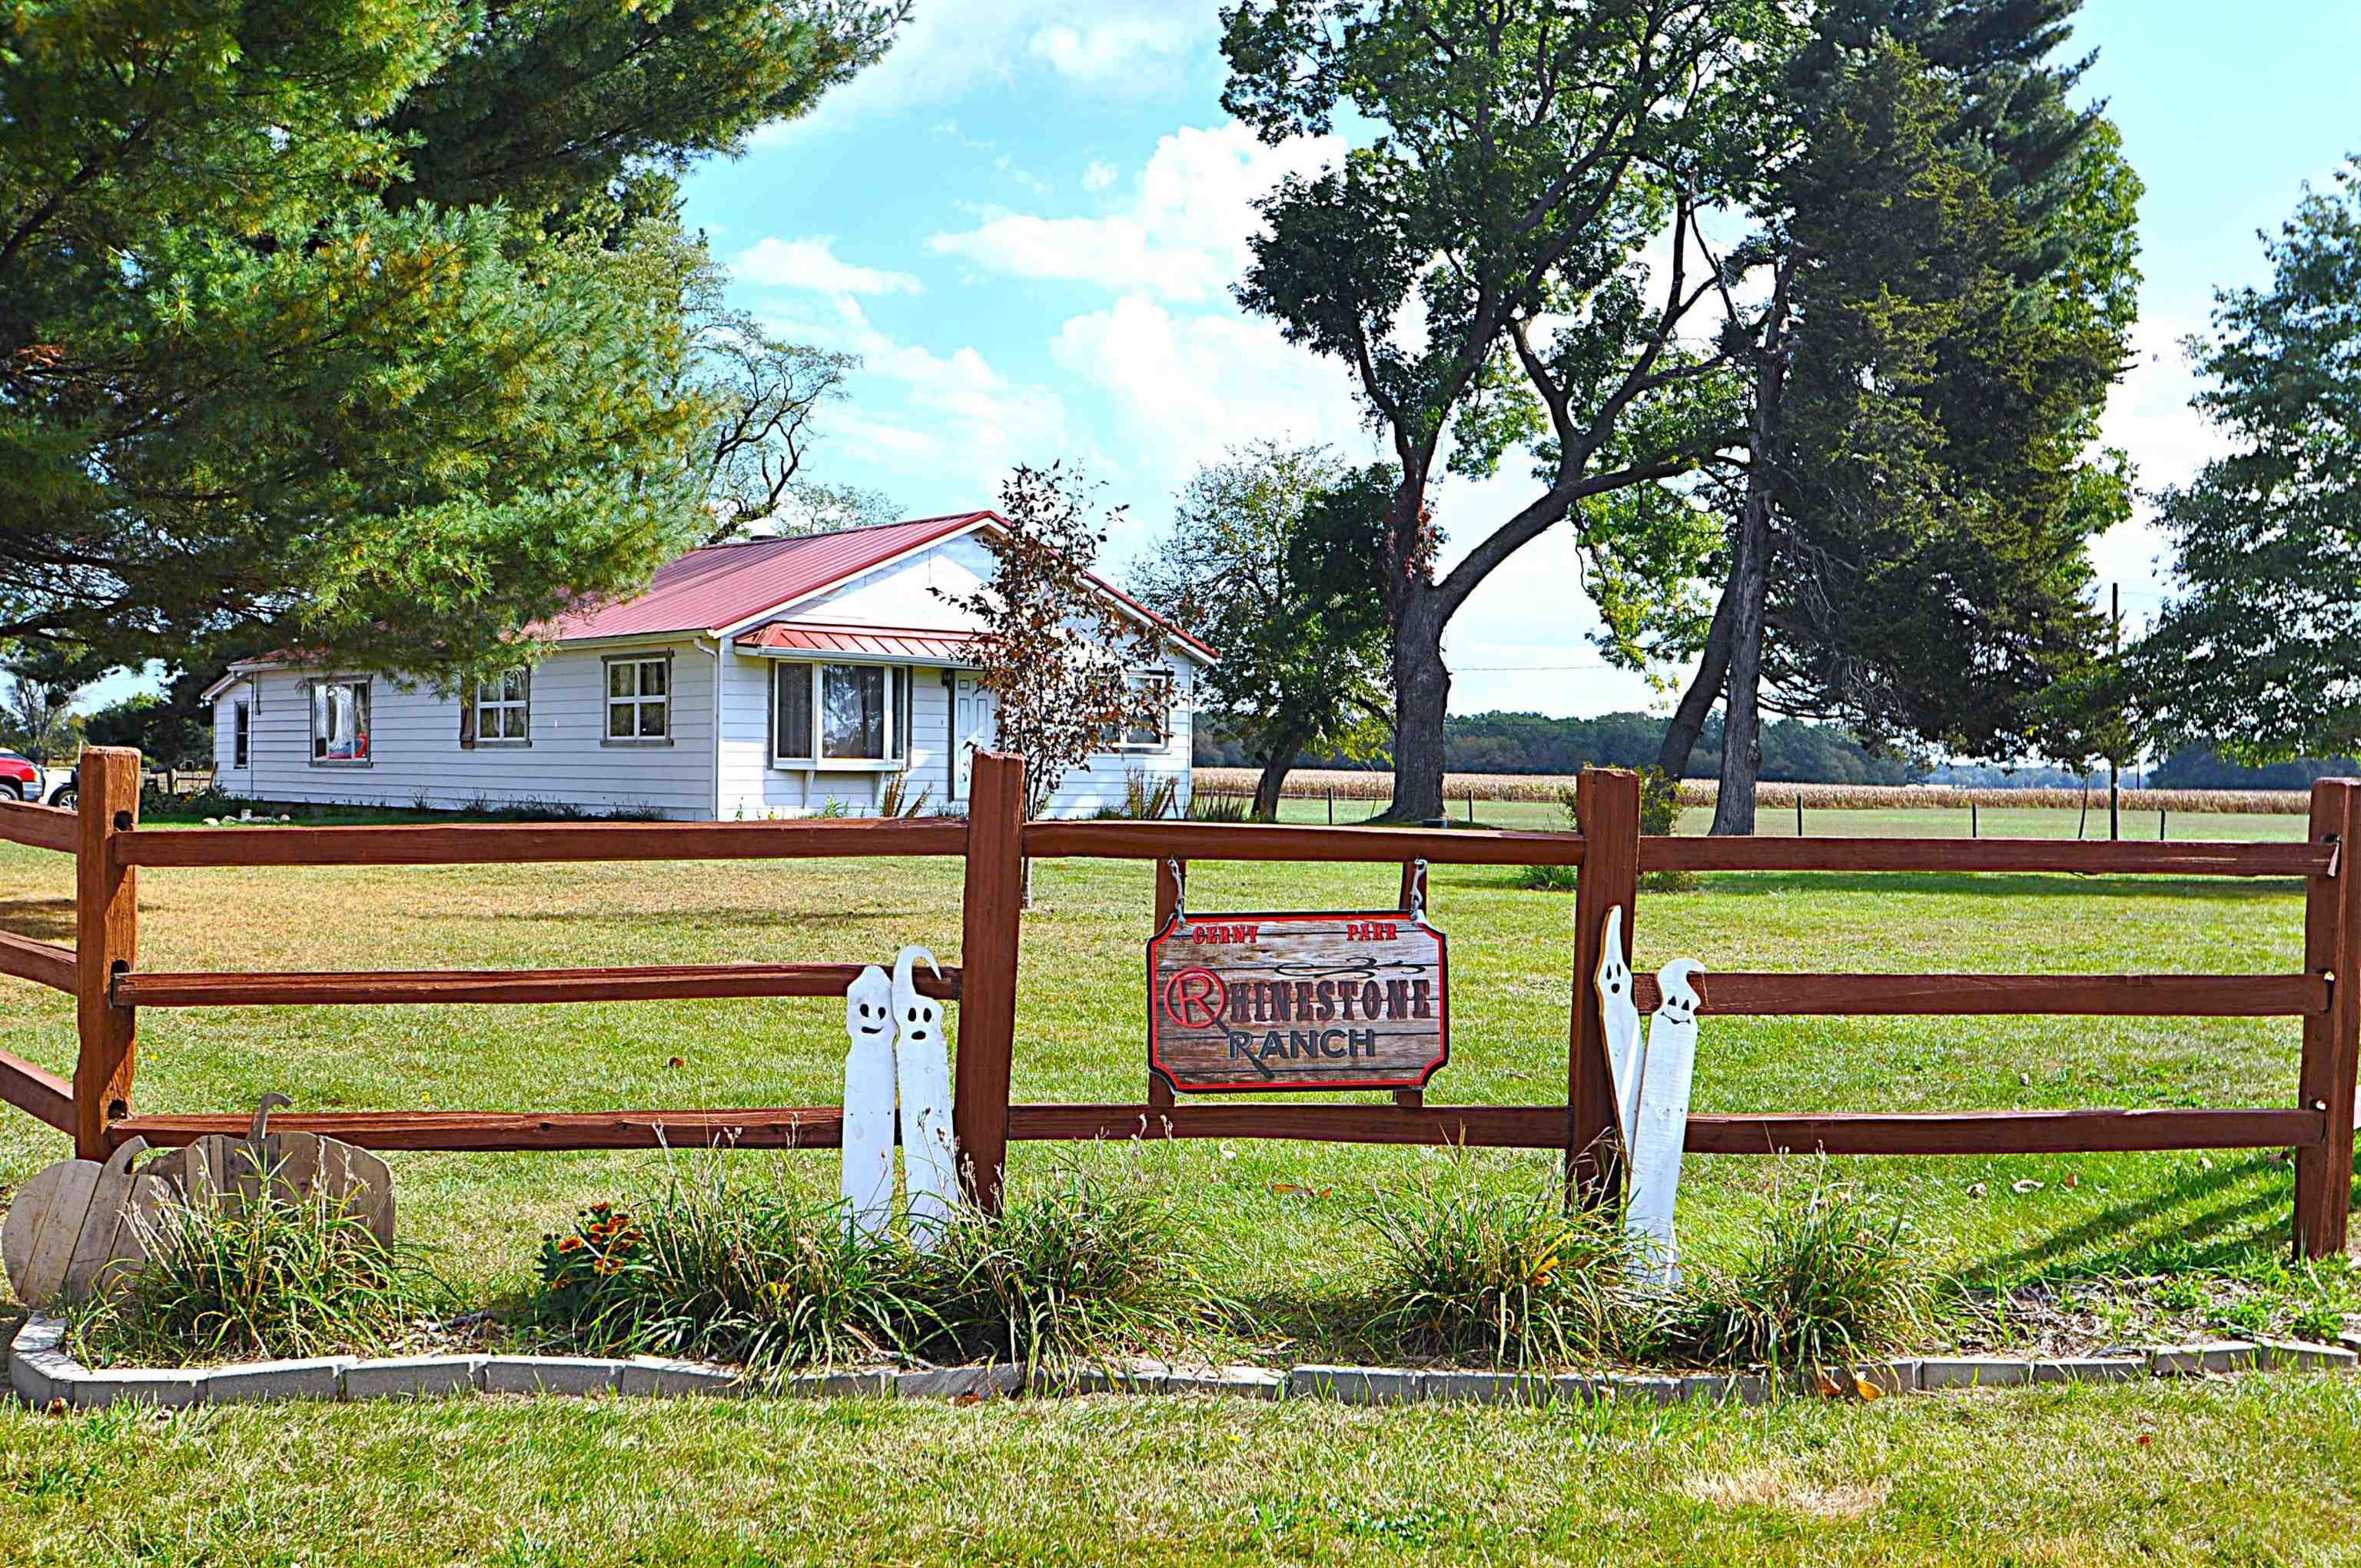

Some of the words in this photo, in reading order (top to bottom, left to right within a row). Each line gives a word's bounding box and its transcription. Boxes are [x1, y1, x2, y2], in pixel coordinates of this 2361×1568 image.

[1193, 925, 1259, 945] CERNY
[1347, 923, 1397, 941] PARR
[1229, 1028, 1376, 1065] RANCH
